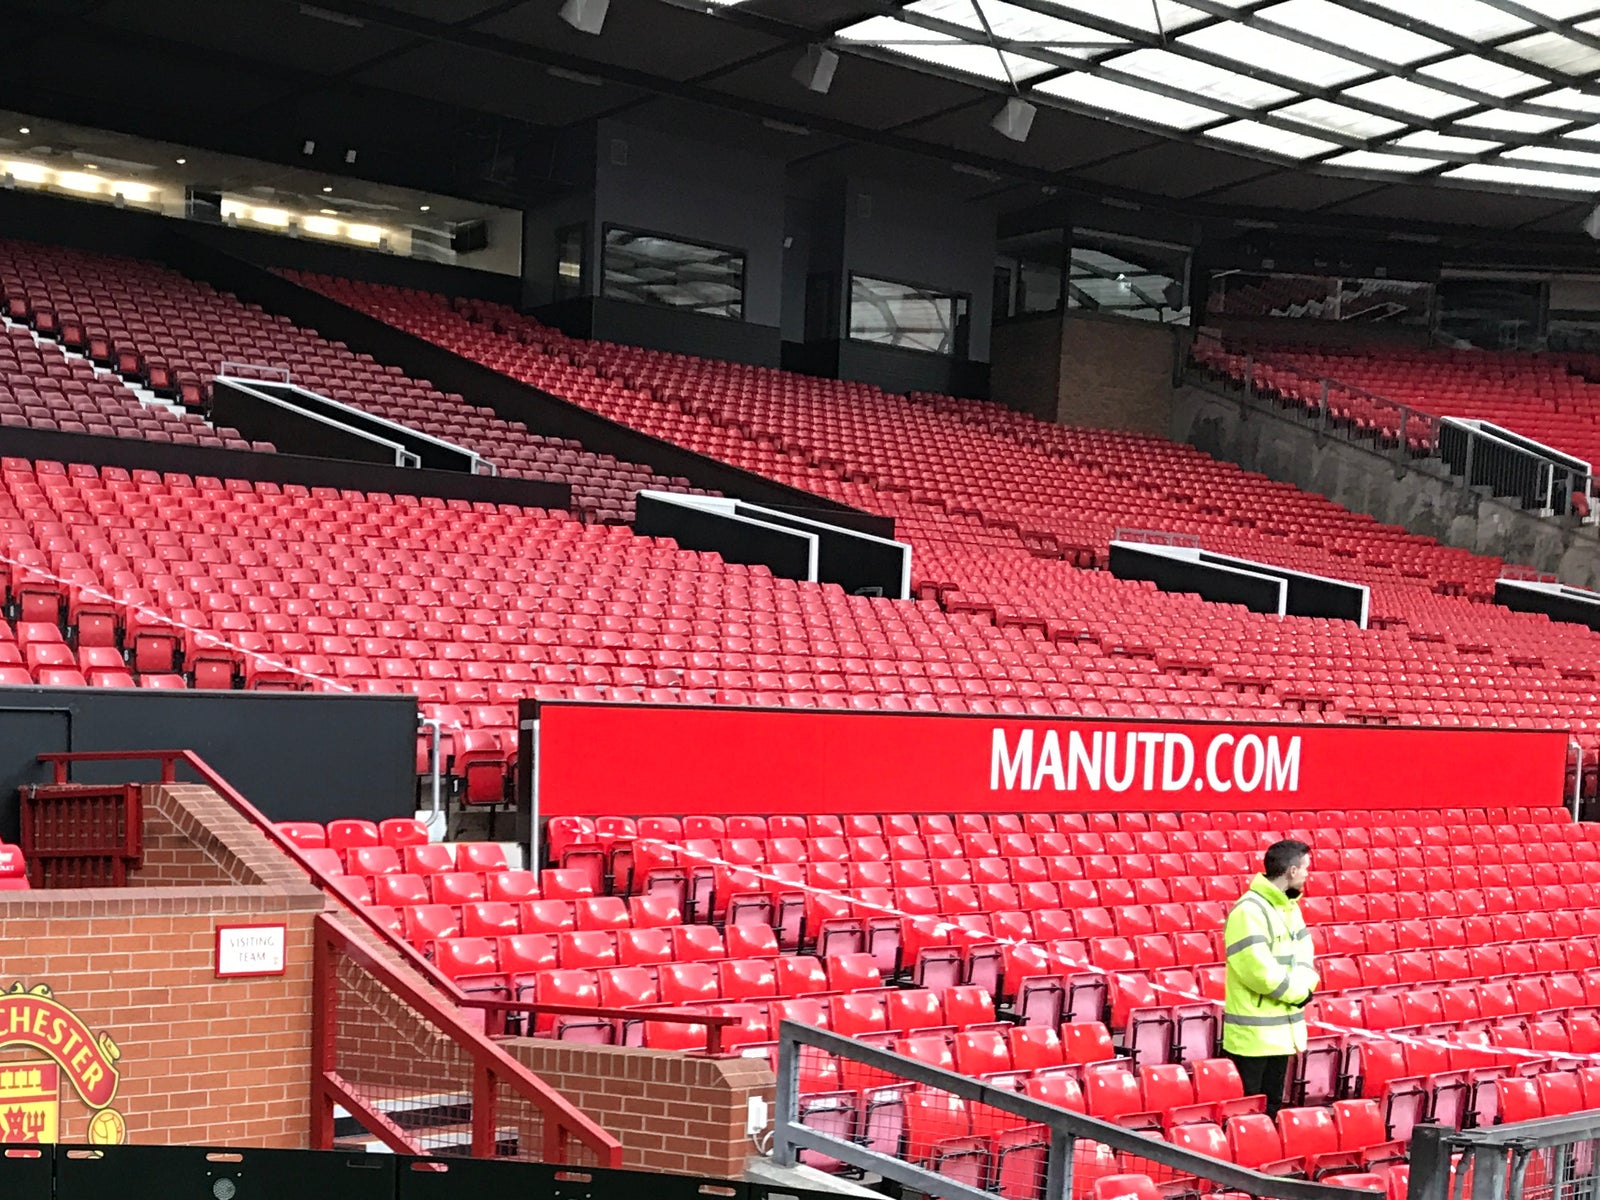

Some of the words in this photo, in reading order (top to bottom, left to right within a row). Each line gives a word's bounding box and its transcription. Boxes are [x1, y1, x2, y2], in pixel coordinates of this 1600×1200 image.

[990, 728, 1301, 792] MANUTD.COM
[230, 936, 275, 947] VISITING
[239, 952, 266, 962] TEAM
